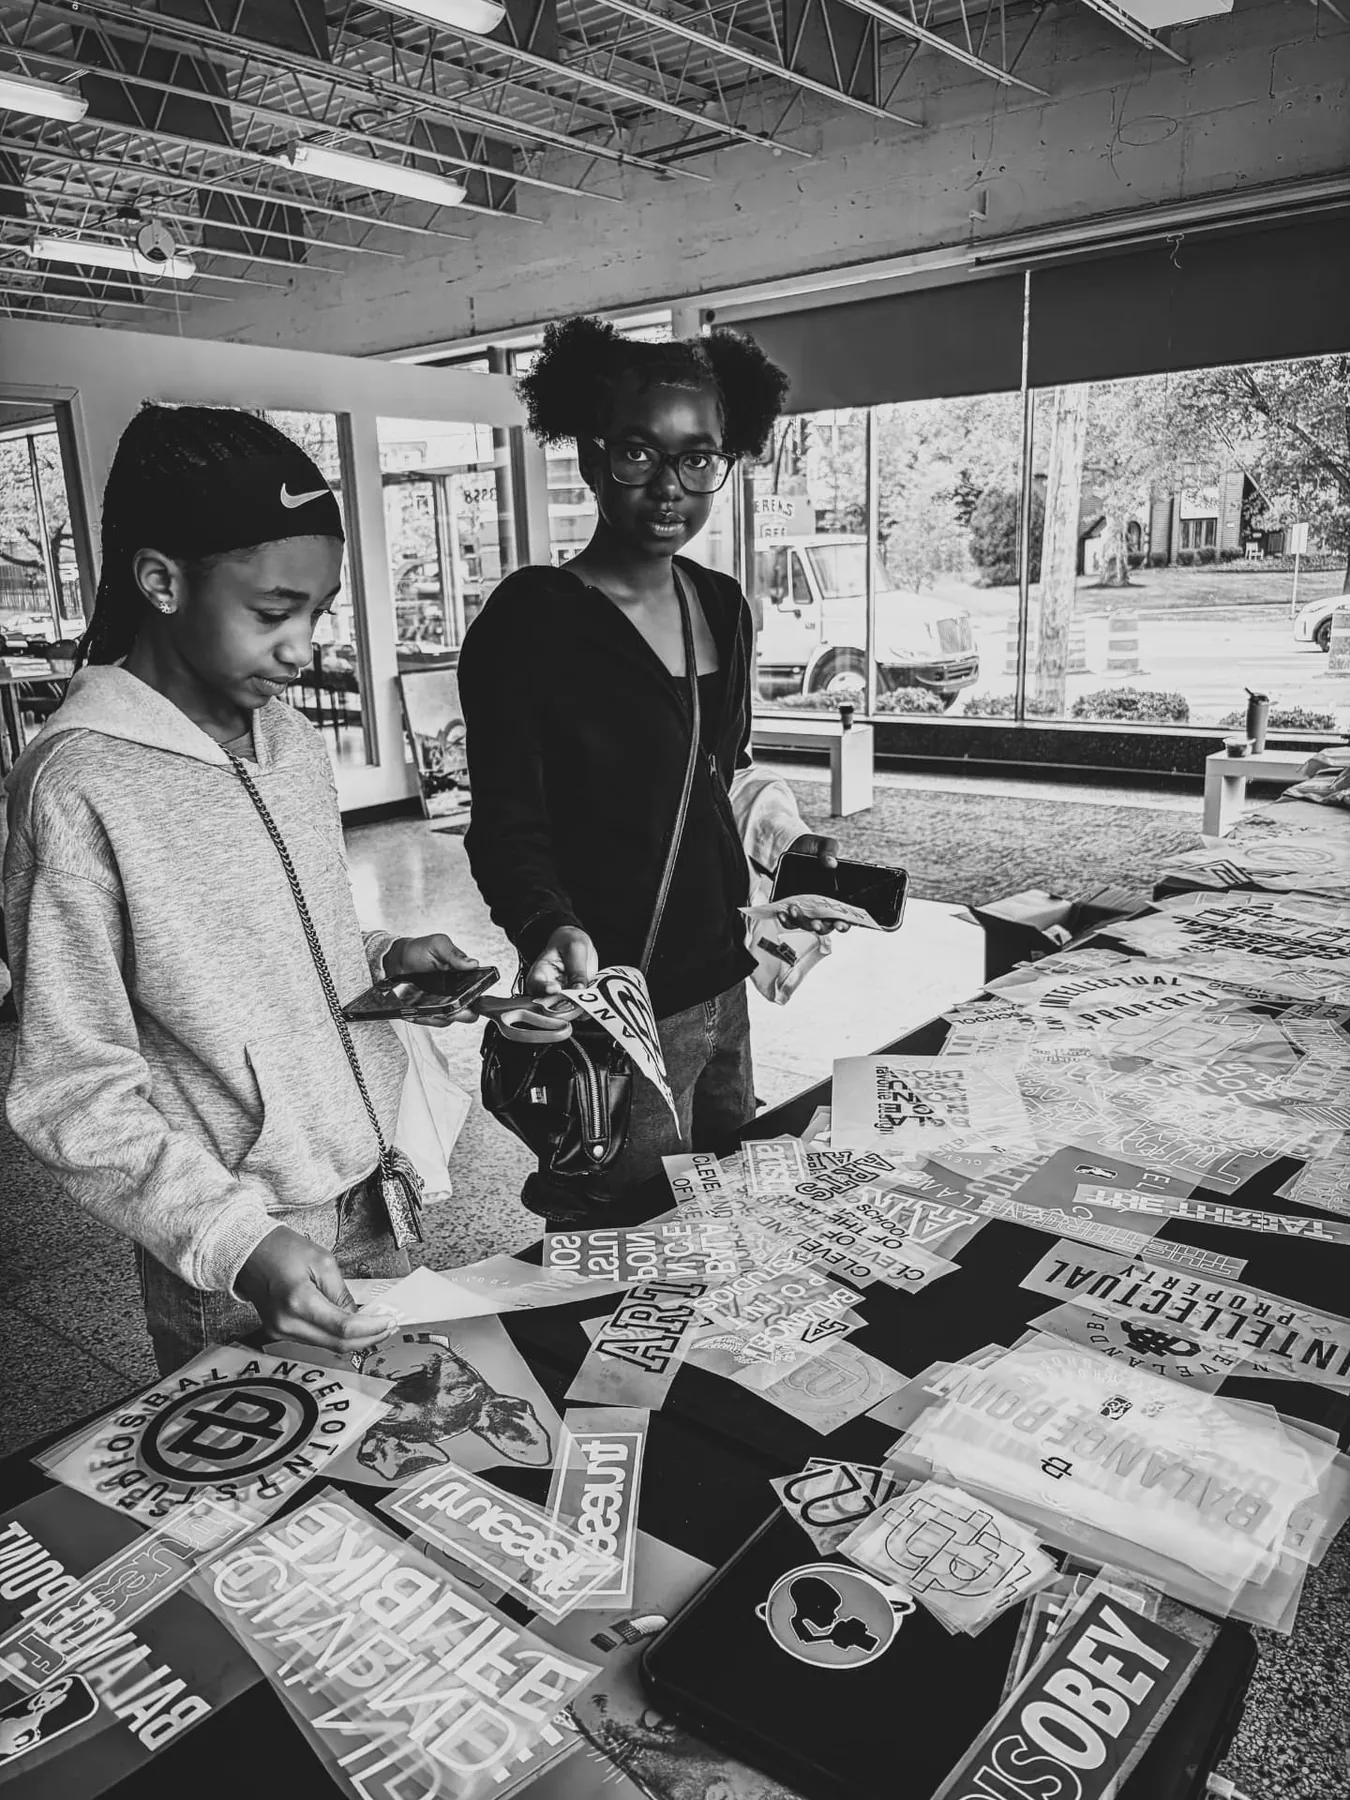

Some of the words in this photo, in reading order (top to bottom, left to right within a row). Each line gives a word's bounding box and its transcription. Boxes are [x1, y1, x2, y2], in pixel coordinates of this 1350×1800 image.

[1039, 975, 1182, 1008] INTELLECTUAL
[1079, 989, 1218, 1025] PROPERTY
[1117, 1264, 1297, 1327] PROPERTY
[958, 1605, 1170, 1800] ISOBEY
